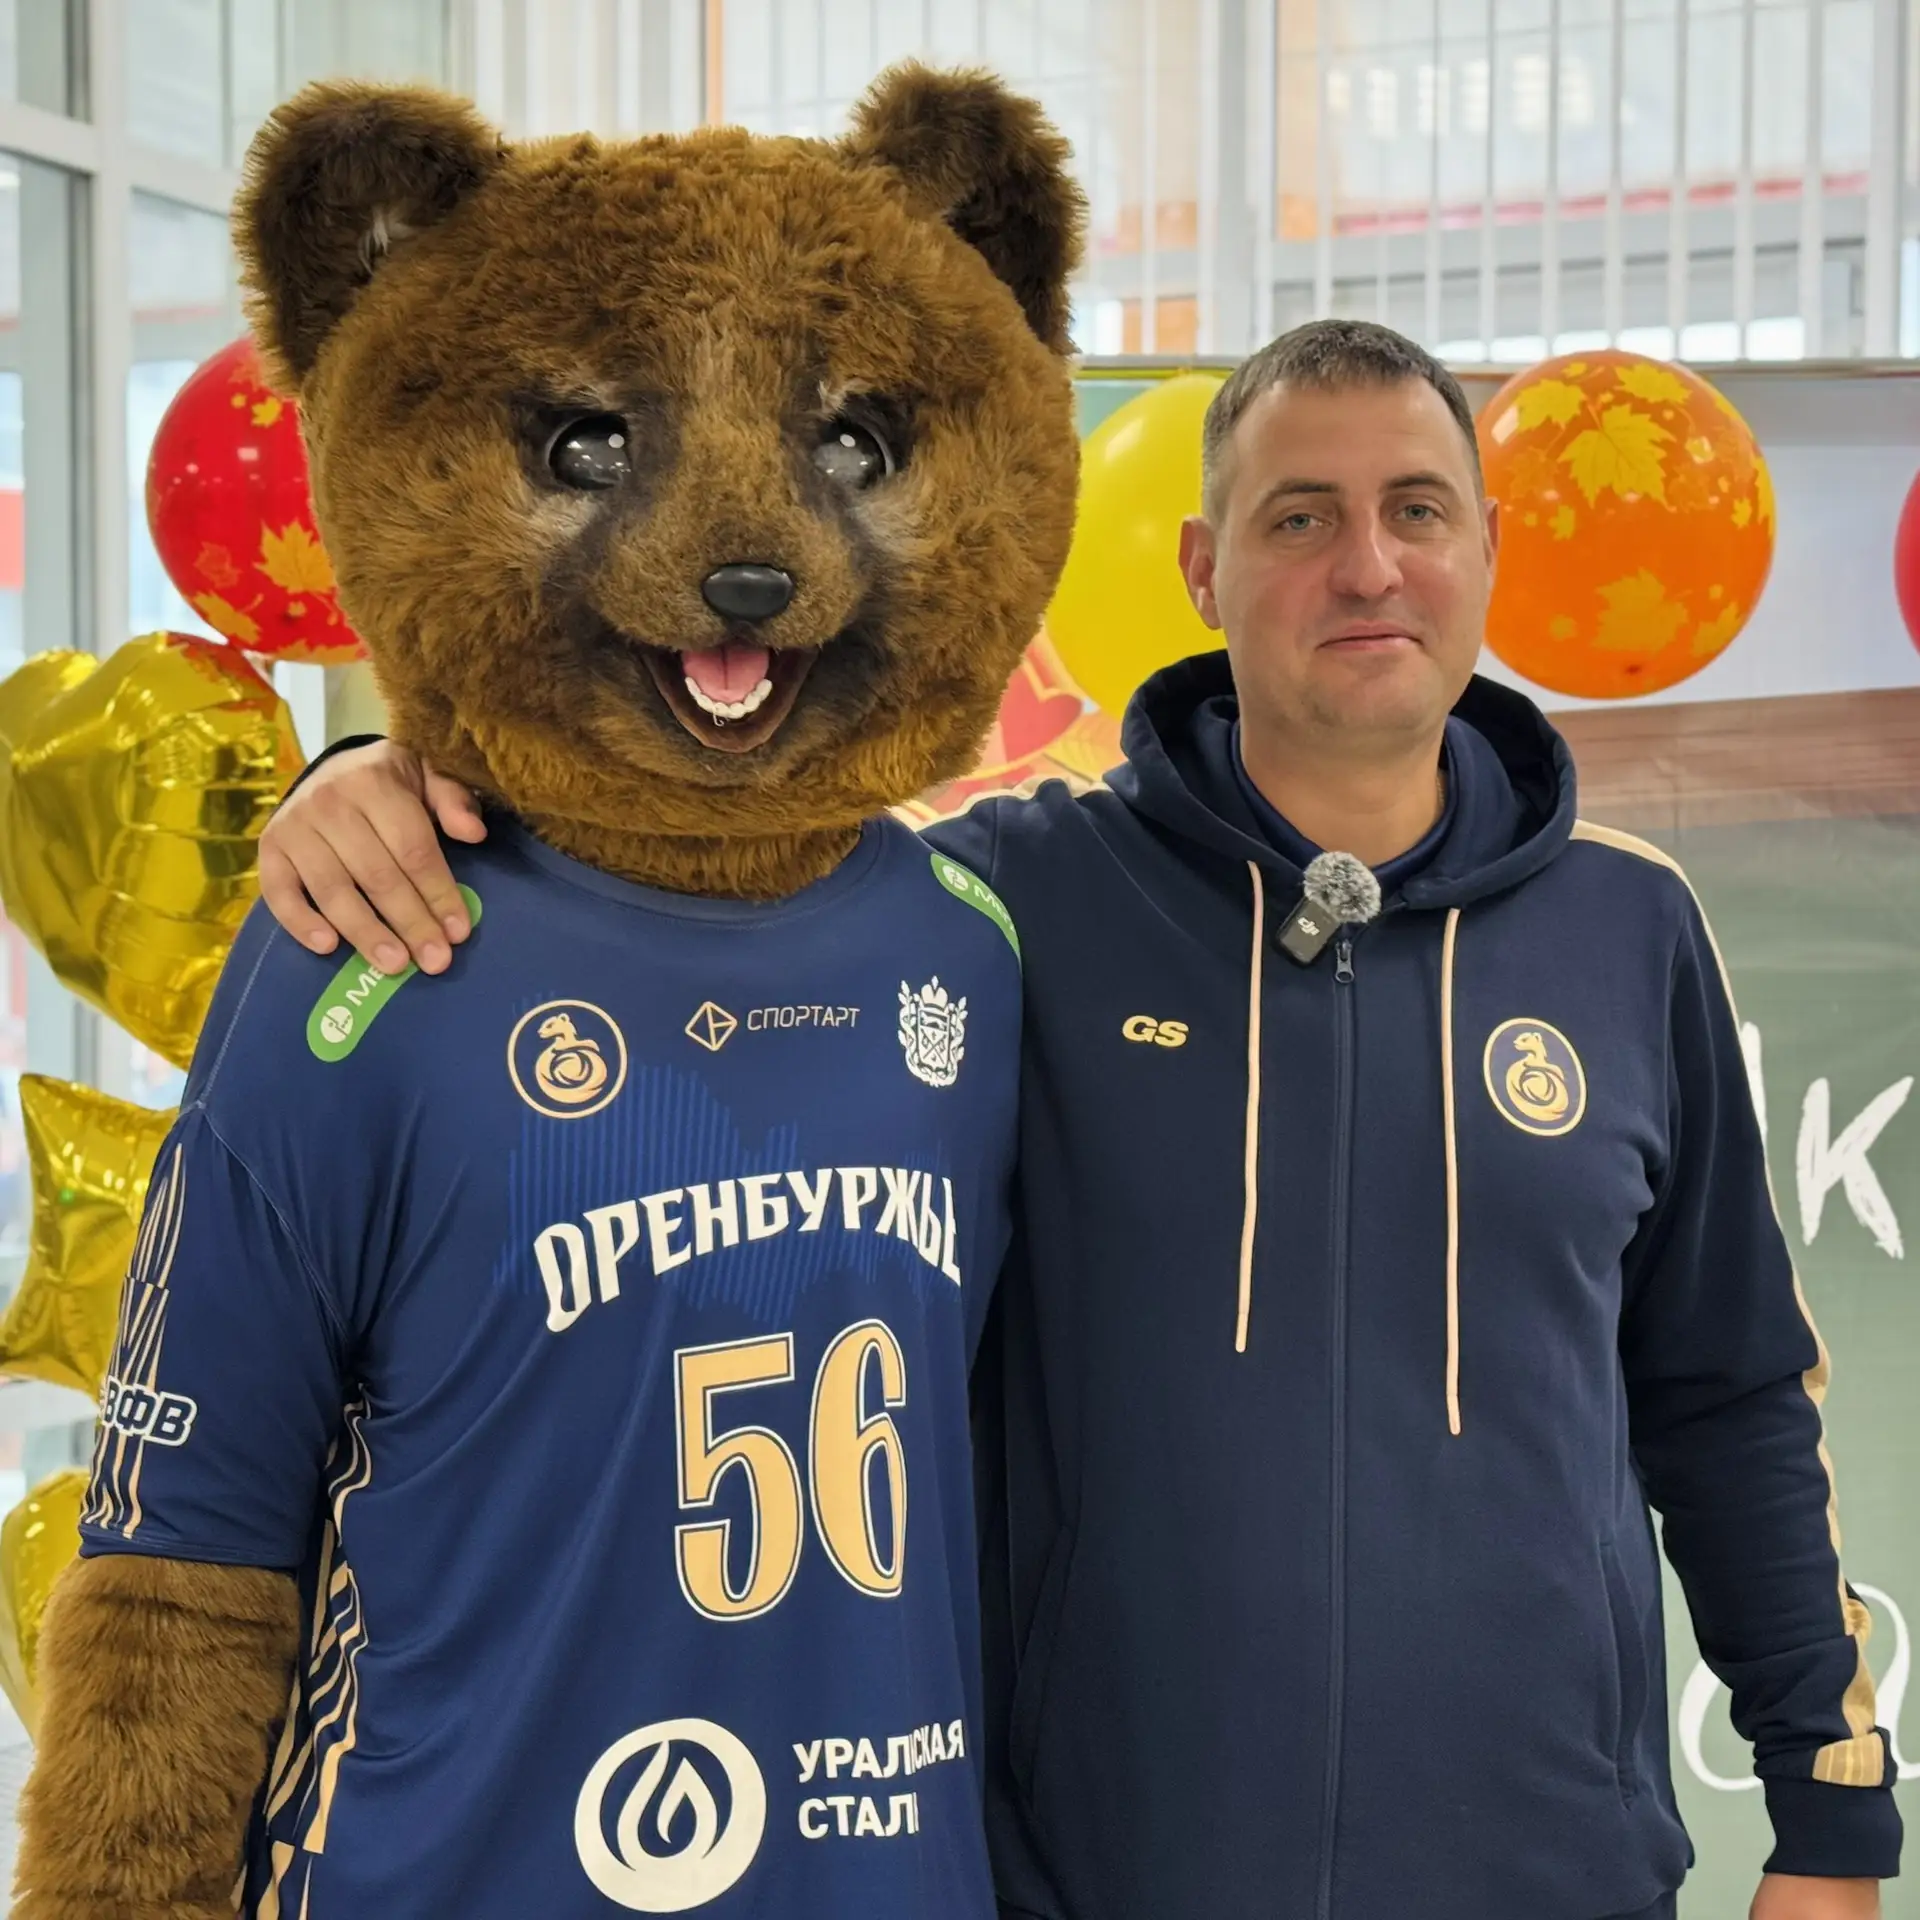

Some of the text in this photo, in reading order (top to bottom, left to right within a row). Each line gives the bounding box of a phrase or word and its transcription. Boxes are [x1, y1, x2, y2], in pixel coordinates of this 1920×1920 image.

[747, 1005, 861, 1031] СПОРТАРТ
[1122, 1015, 1189, 1047] GS
[674, 1318, 907, 1622] 56
